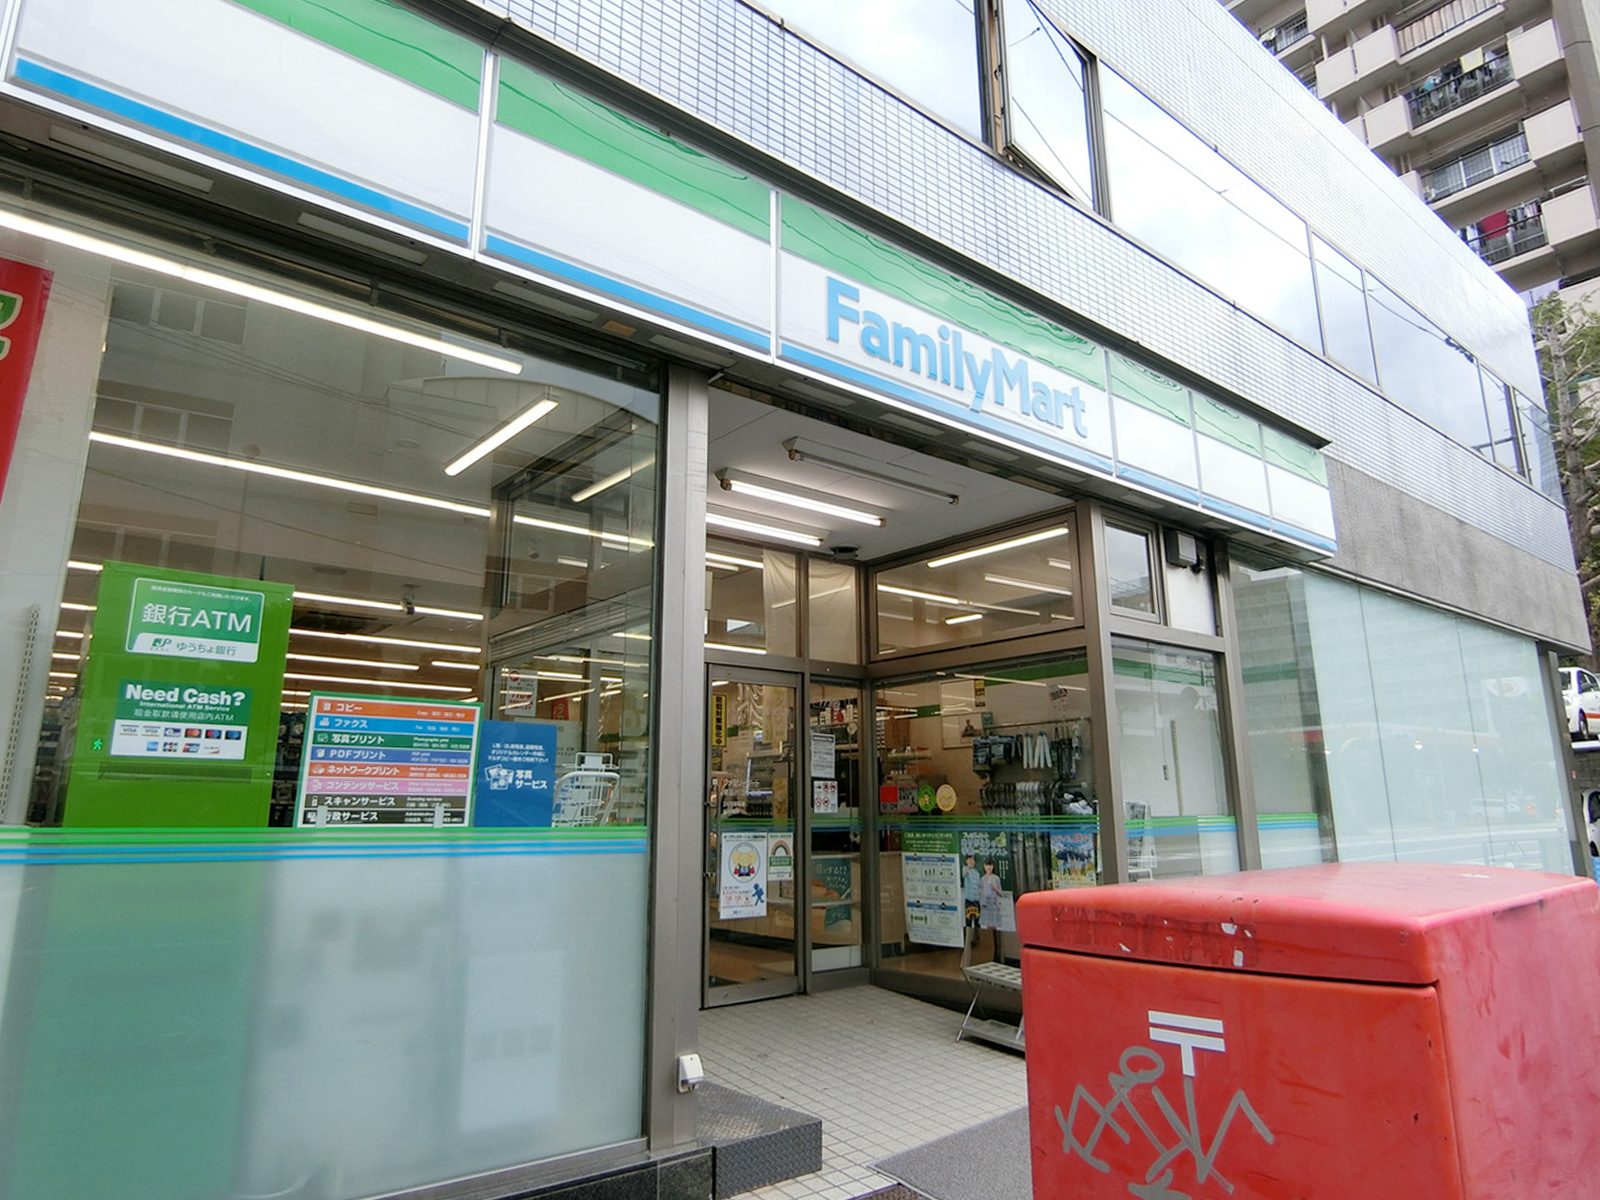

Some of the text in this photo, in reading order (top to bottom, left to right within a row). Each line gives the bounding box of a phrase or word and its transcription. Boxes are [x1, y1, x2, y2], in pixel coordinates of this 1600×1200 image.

[826, 276, 1088, 439] FamilyMart
[142, 603, 252, 633] 銀行ATM
[176, 642, 238, 656] ゆうちょ銀行
[125, 684, 246, 706] Need Cash?
[139, 700, 186, 709] International
[204, 704, 230, 712] Service
[336, 703, 363, 712] コピー
[334, 718, 368, 728] ファクス
[331, 733, 385, 745] 写真プリント
[329, 749, 386, 760] PDFプリント
[327, 765, 400, 776] ネットワークプリント
[515, 769, 533, 779] 写真
[326, 781, 399, 791] コンテンツサービス
[515, 780, 547, 790] サービス
[324, 796, 396, 806] スキャンサービス
